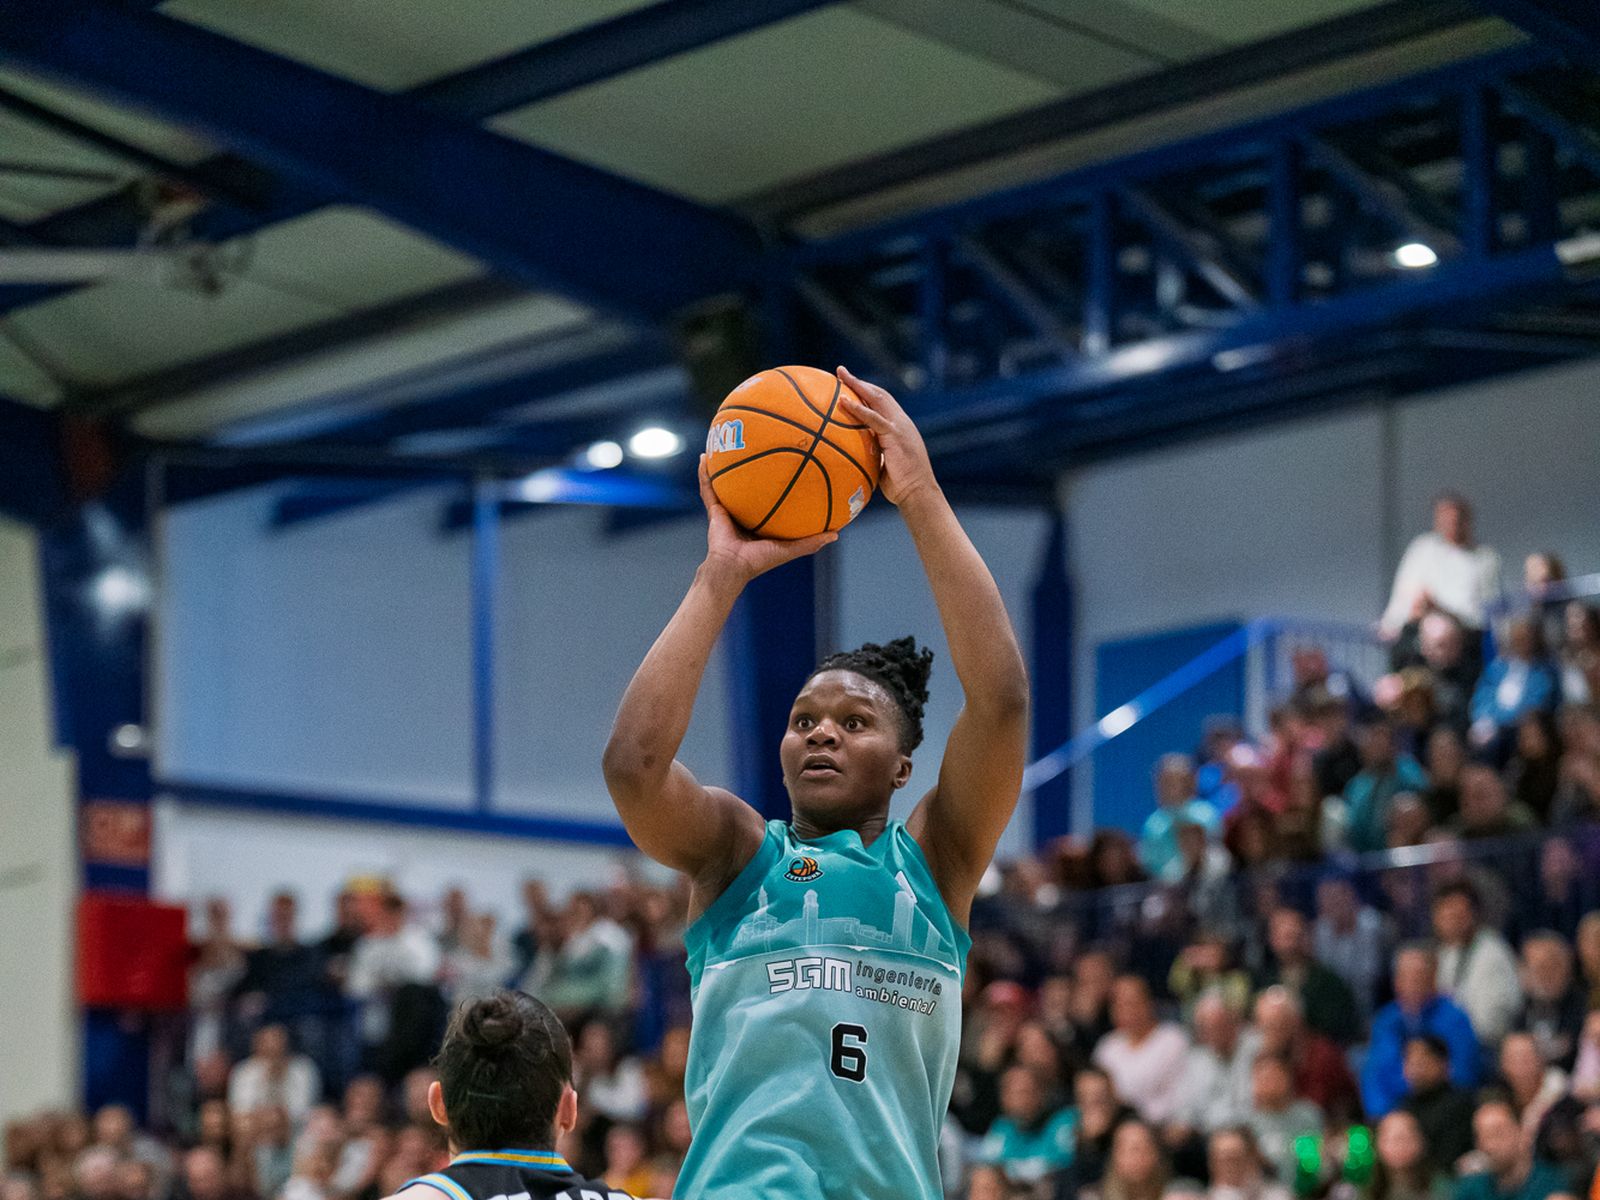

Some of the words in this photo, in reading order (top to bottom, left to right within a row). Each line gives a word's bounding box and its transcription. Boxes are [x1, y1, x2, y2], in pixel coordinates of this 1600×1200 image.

[766, 957, 852, 994] SGM
[855, 960, 943, 996] ingeniería
[855, 985, 937, 1015] ambiental
[830, 1021, 868, 1084] 6
